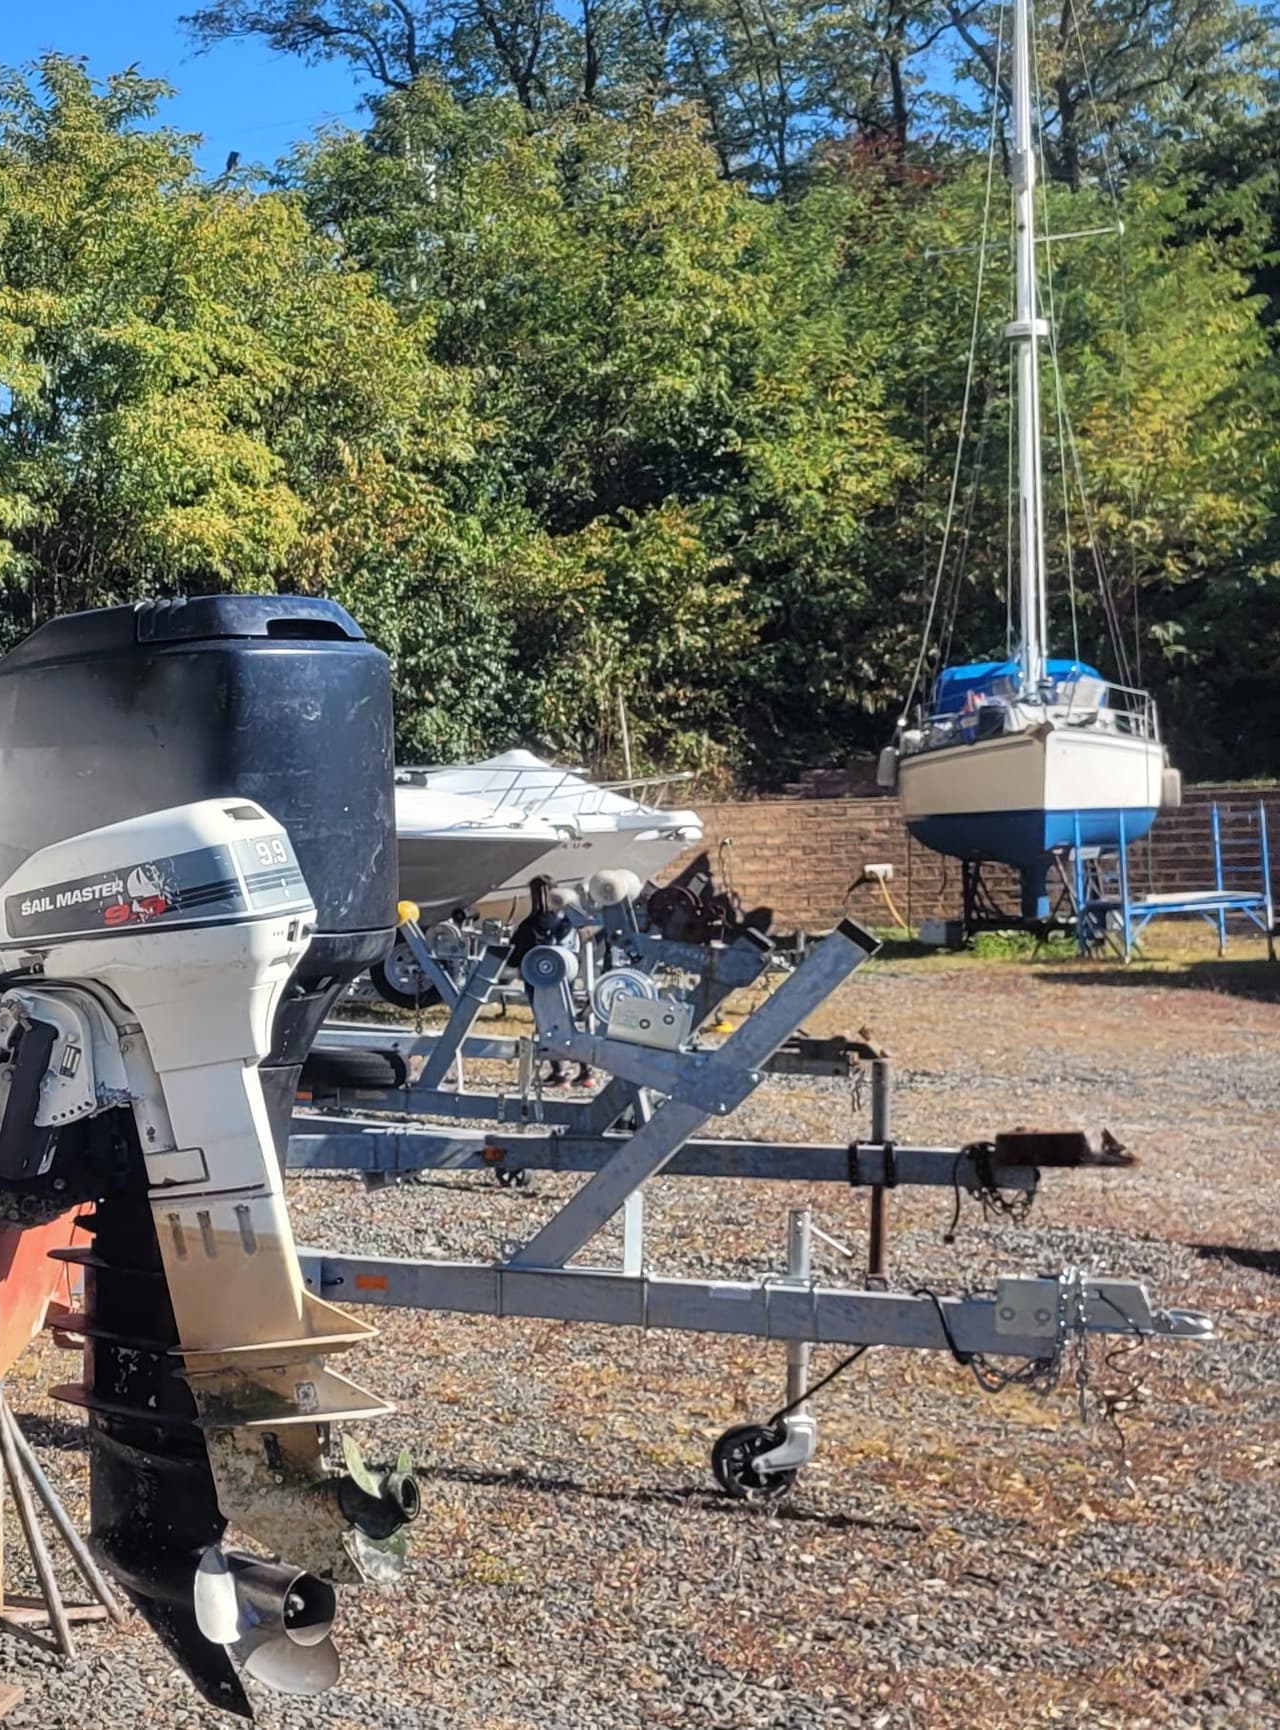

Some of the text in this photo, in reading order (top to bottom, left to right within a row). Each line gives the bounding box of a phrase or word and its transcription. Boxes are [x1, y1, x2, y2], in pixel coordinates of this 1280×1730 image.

[255, 839, 288, 866] 9.9
[20, 878, 125, 917] SAIL MASTER
